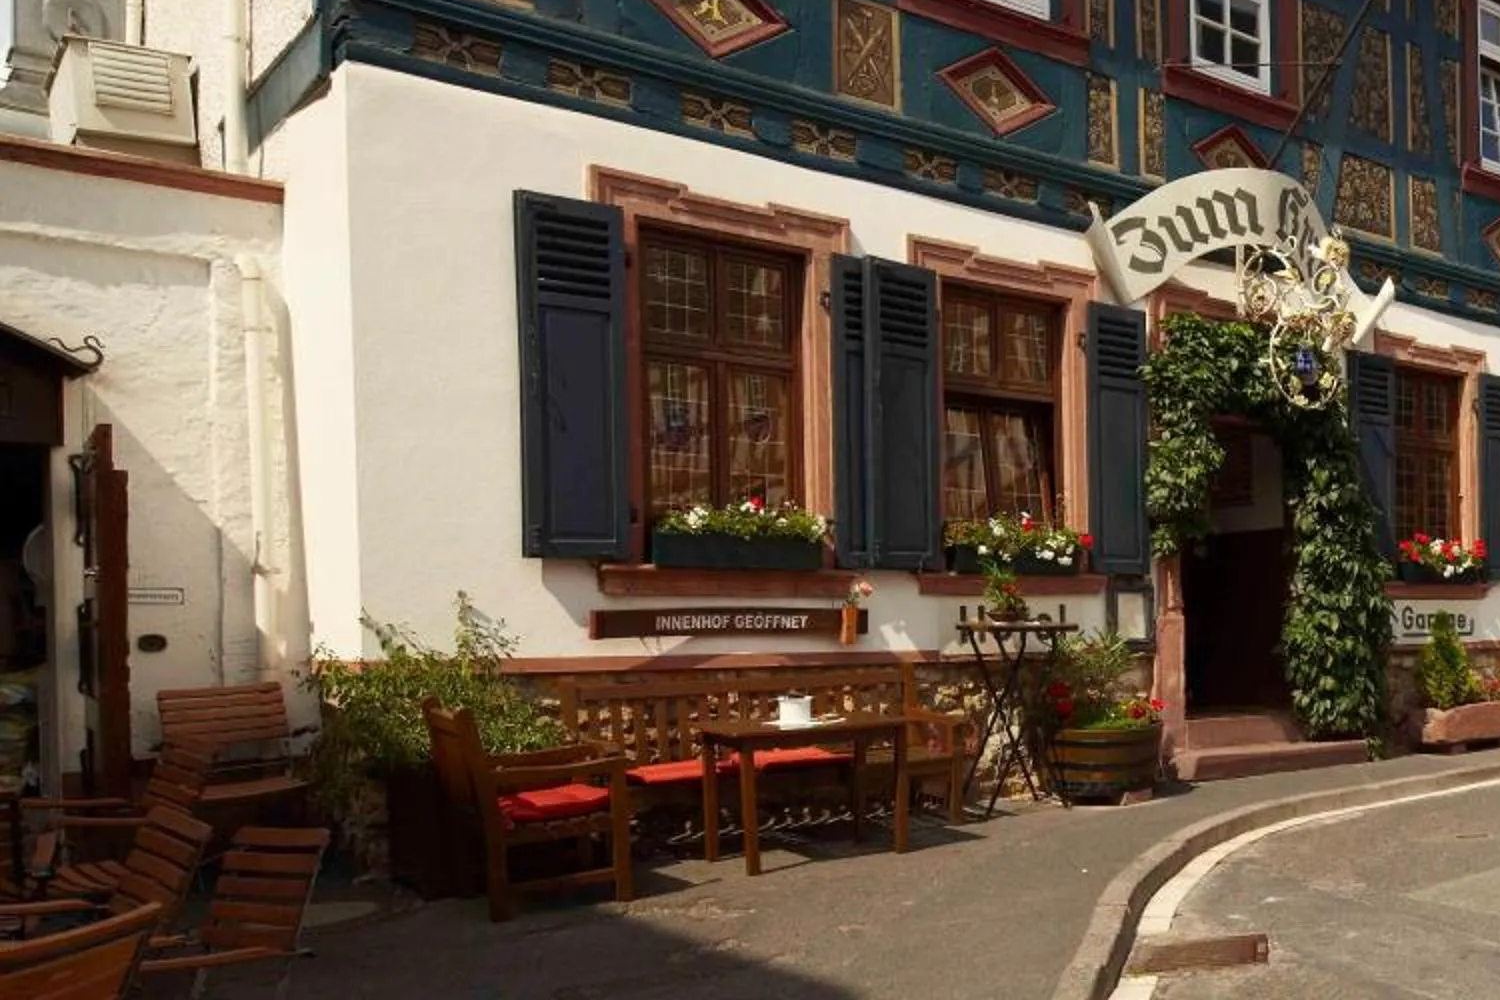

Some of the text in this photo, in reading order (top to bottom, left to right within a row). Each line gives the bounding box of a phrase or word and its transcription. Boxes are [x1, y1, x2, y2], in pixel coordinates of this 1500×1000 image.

[1111, 187, 1265, 274] Zum
[655, 612, 809, 631] INNENHOF GEÖFFNET
[1402, 605, 1467, 630] Gare
